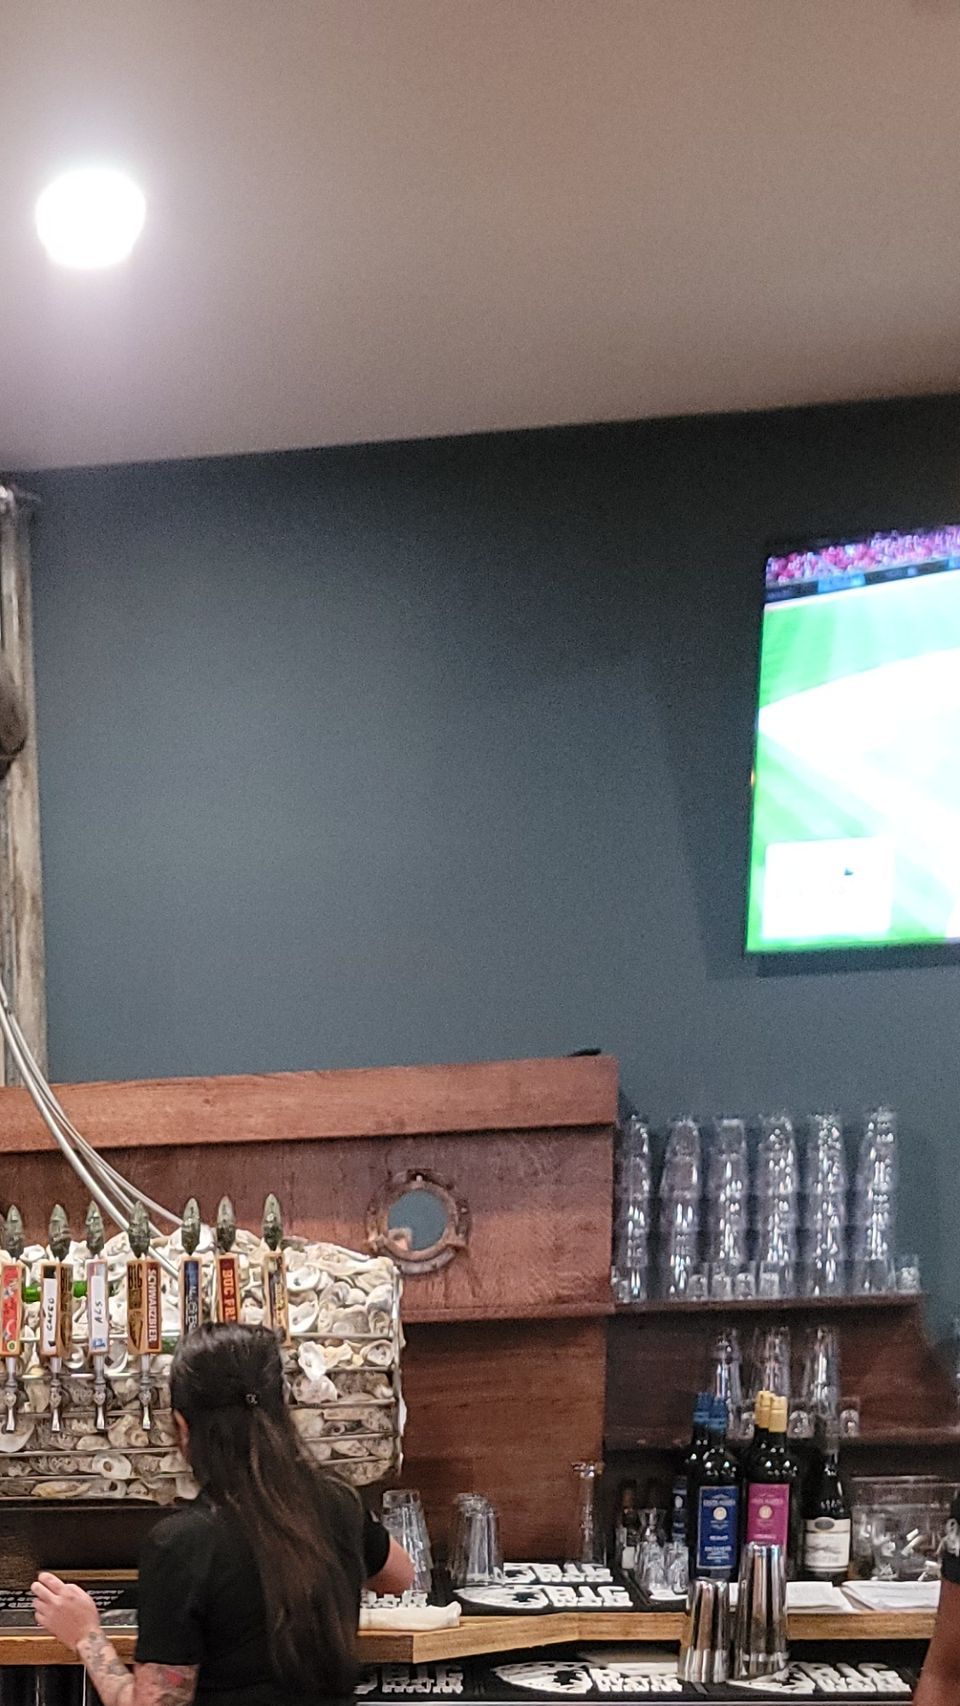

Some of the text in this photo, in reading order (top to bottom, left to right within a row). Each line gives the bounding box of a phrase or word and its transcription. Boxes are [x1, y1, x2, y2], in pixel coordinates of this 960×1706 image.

[128, 1264, 143, 1290] BIG
[222, 1268, 234, 1296] BUC
[147, 1268, 158, 1342] SCHWARZBIER
